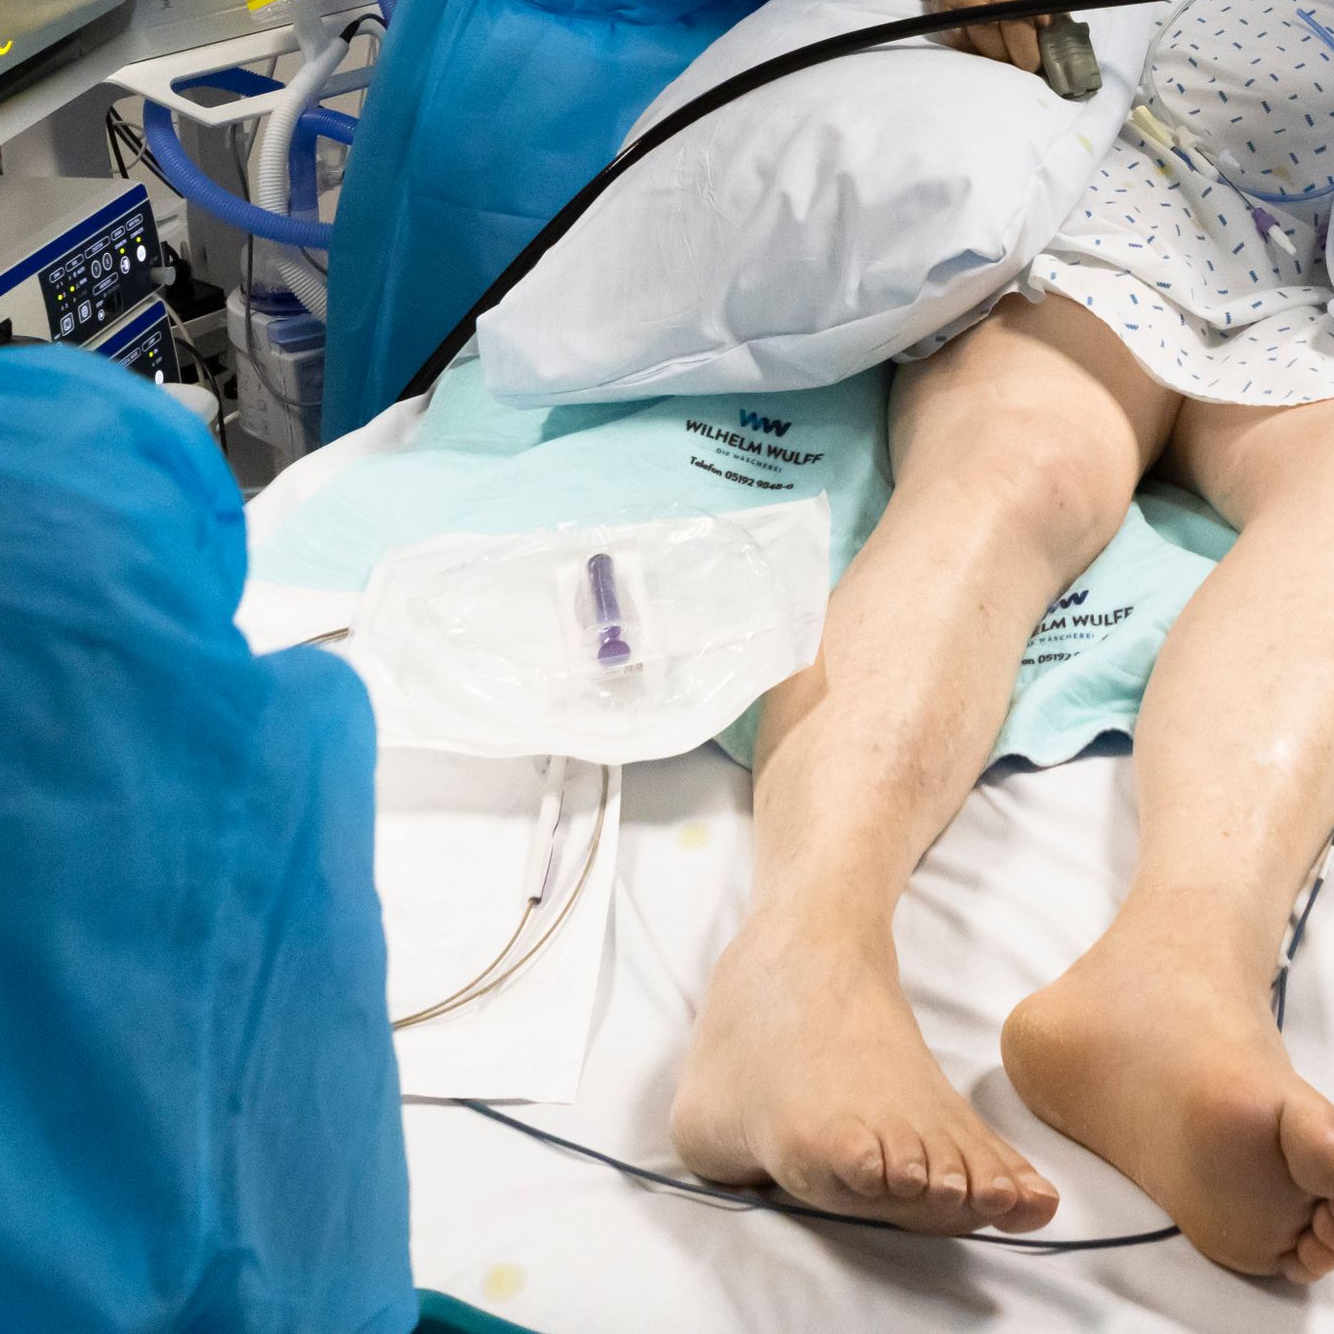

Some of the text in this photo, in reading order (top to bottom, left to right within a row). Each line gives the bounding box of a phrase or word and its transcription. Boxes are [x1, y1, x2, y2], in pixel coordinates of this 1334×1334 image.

[685, 419, 824, 465] WILHELM WULFF
[690, 455, 723, 477] Telefon
[724, 470, 754, 487] 05192
[1072, 606, 1134, 627] WULFF
